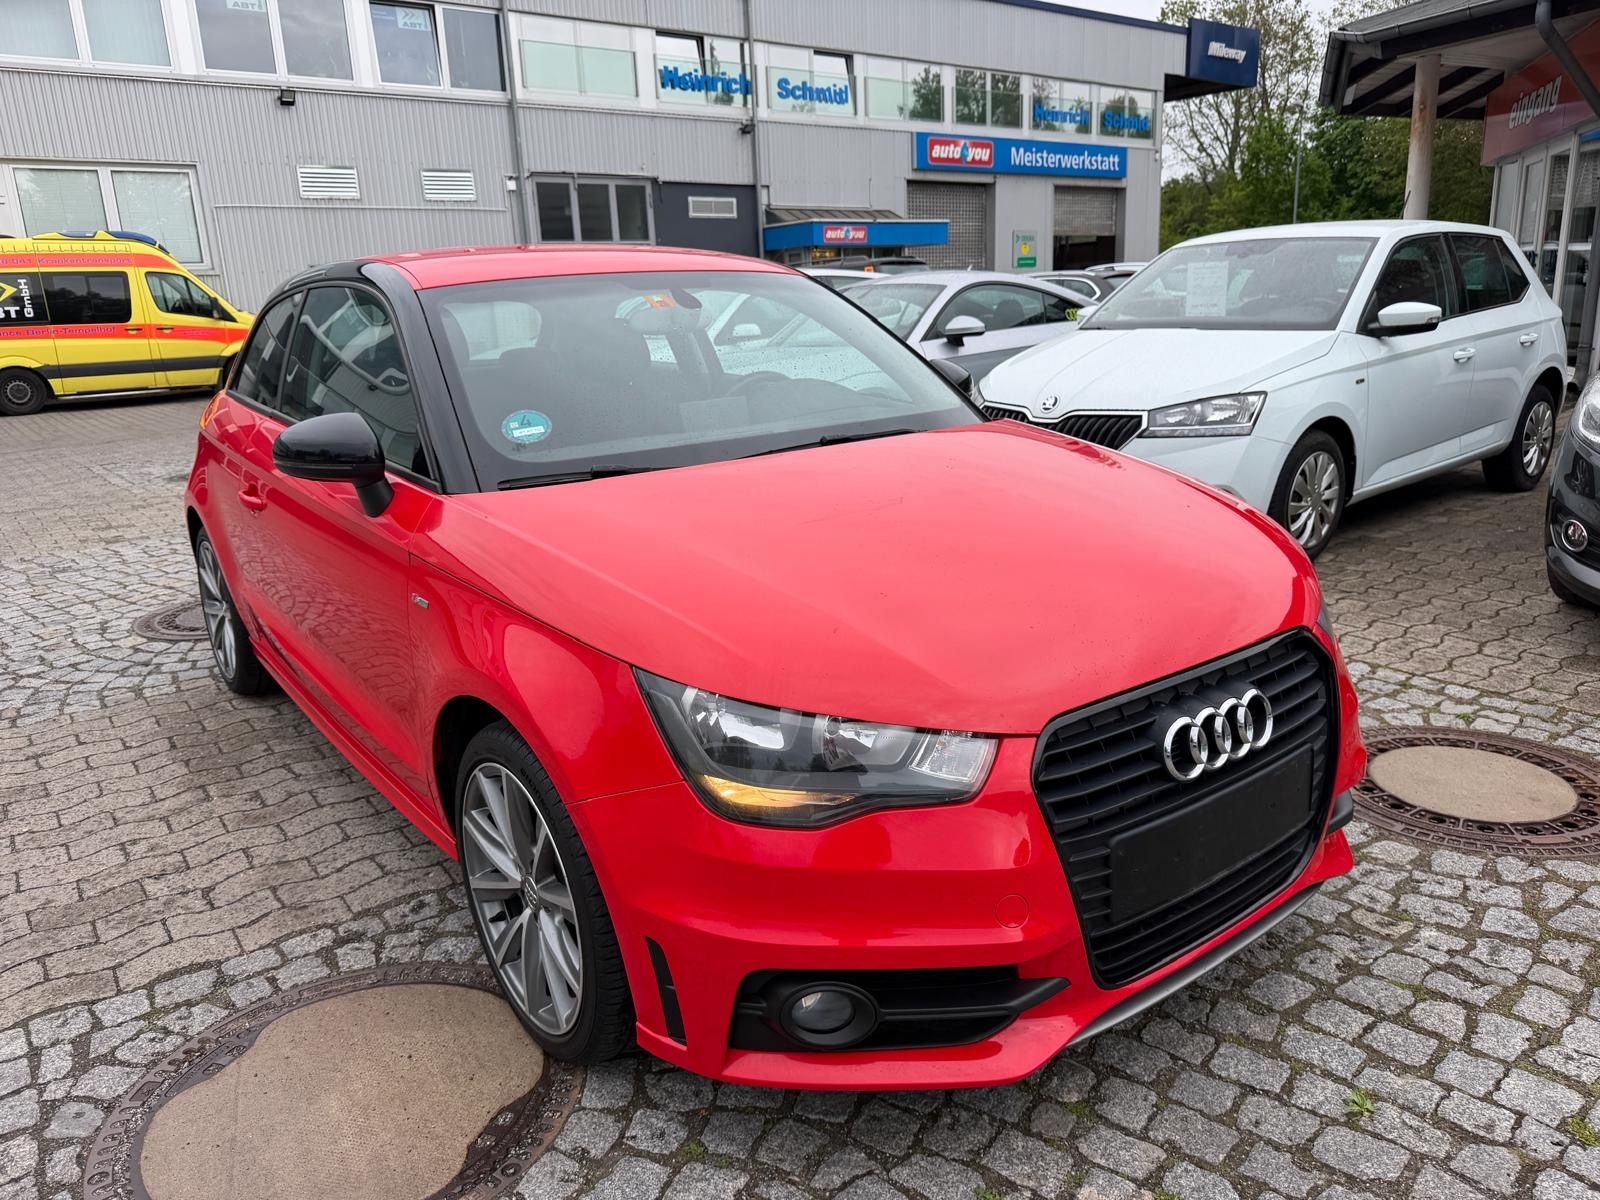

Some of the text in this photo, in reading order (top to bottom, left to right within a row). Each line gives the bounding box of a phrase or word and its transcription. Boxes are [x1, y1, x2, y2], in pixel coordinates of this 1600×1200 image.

[659, 65, 752, 95] Heinrich
[1508, 75, 1563, 129] eingang
[1033, 104, 1150, 130] Heinrich Schmid
[1010, 147, 1120, 171] Meisterwerkstatt
[18, 279, 34, 318] GmbH
[520, 414, 532, 427] 4
